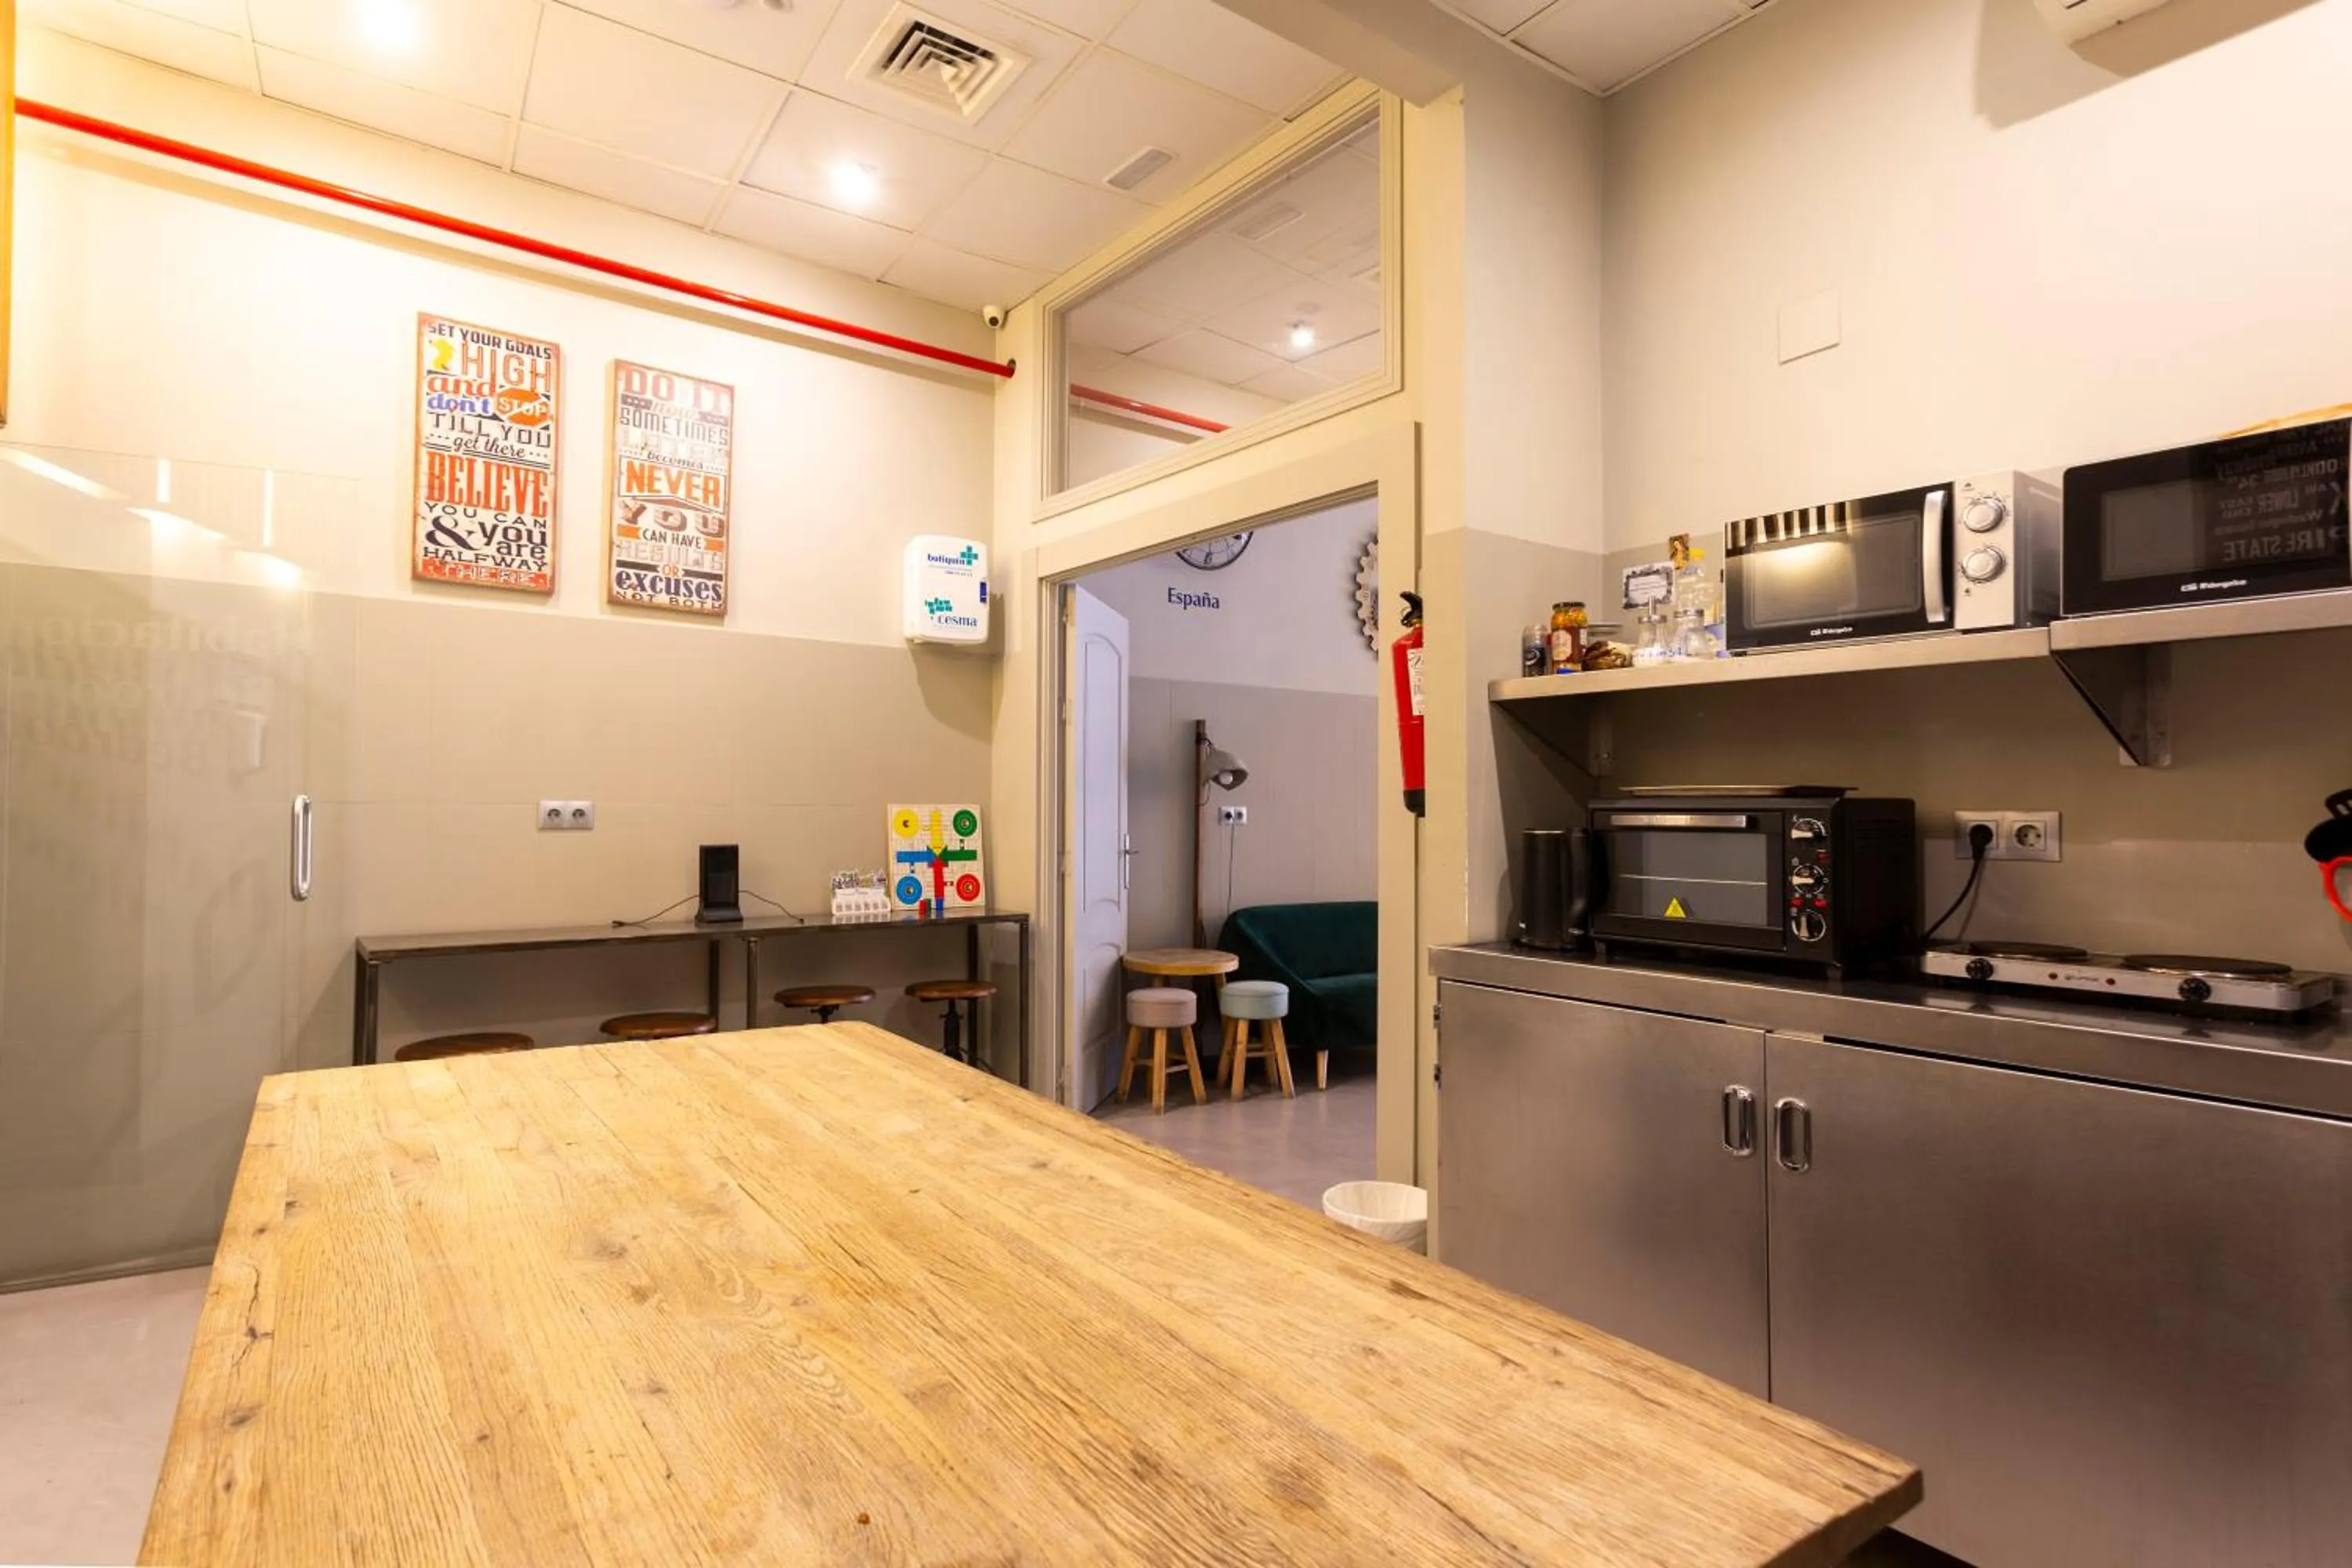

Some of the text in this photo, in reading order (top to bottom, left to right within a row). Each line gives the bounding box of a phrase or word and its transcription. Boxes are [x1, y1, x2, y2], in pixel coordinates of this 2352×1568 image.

[428, 322, 551, 359] SET YOUR GOALS
[462, 342, 551, 392] HIGH
[427, 376, 496, 397] and
[623, 367, 729, 412] DO IT
[427, 394, 490, 414] don't
[498, 397, 549, 417] STOP
[434, 413, 551, 448] TILL YOU
[619, 406, 729, 446] SOMETIMES
[452, 435, 525, 459] get there
[426, 450, 548, 518] BELIEVE
[626, 461, 720, 508] NEVER
[424, 502, 547, 529] YOU CAN
[619, 499, 725, 539] YOU
[426, 515, 548, 551] & you
[642, 528, 702, 550] CAN HAVE
[423, 546, 548, 572] HALFWAY
[496, 541, 546, 560] are
[661, 564, 681, 577] OR
[615, 570, 723, 601] excuses
[615, 590, 656, 604] NOT
[1167, 587, 1220, 610] España
